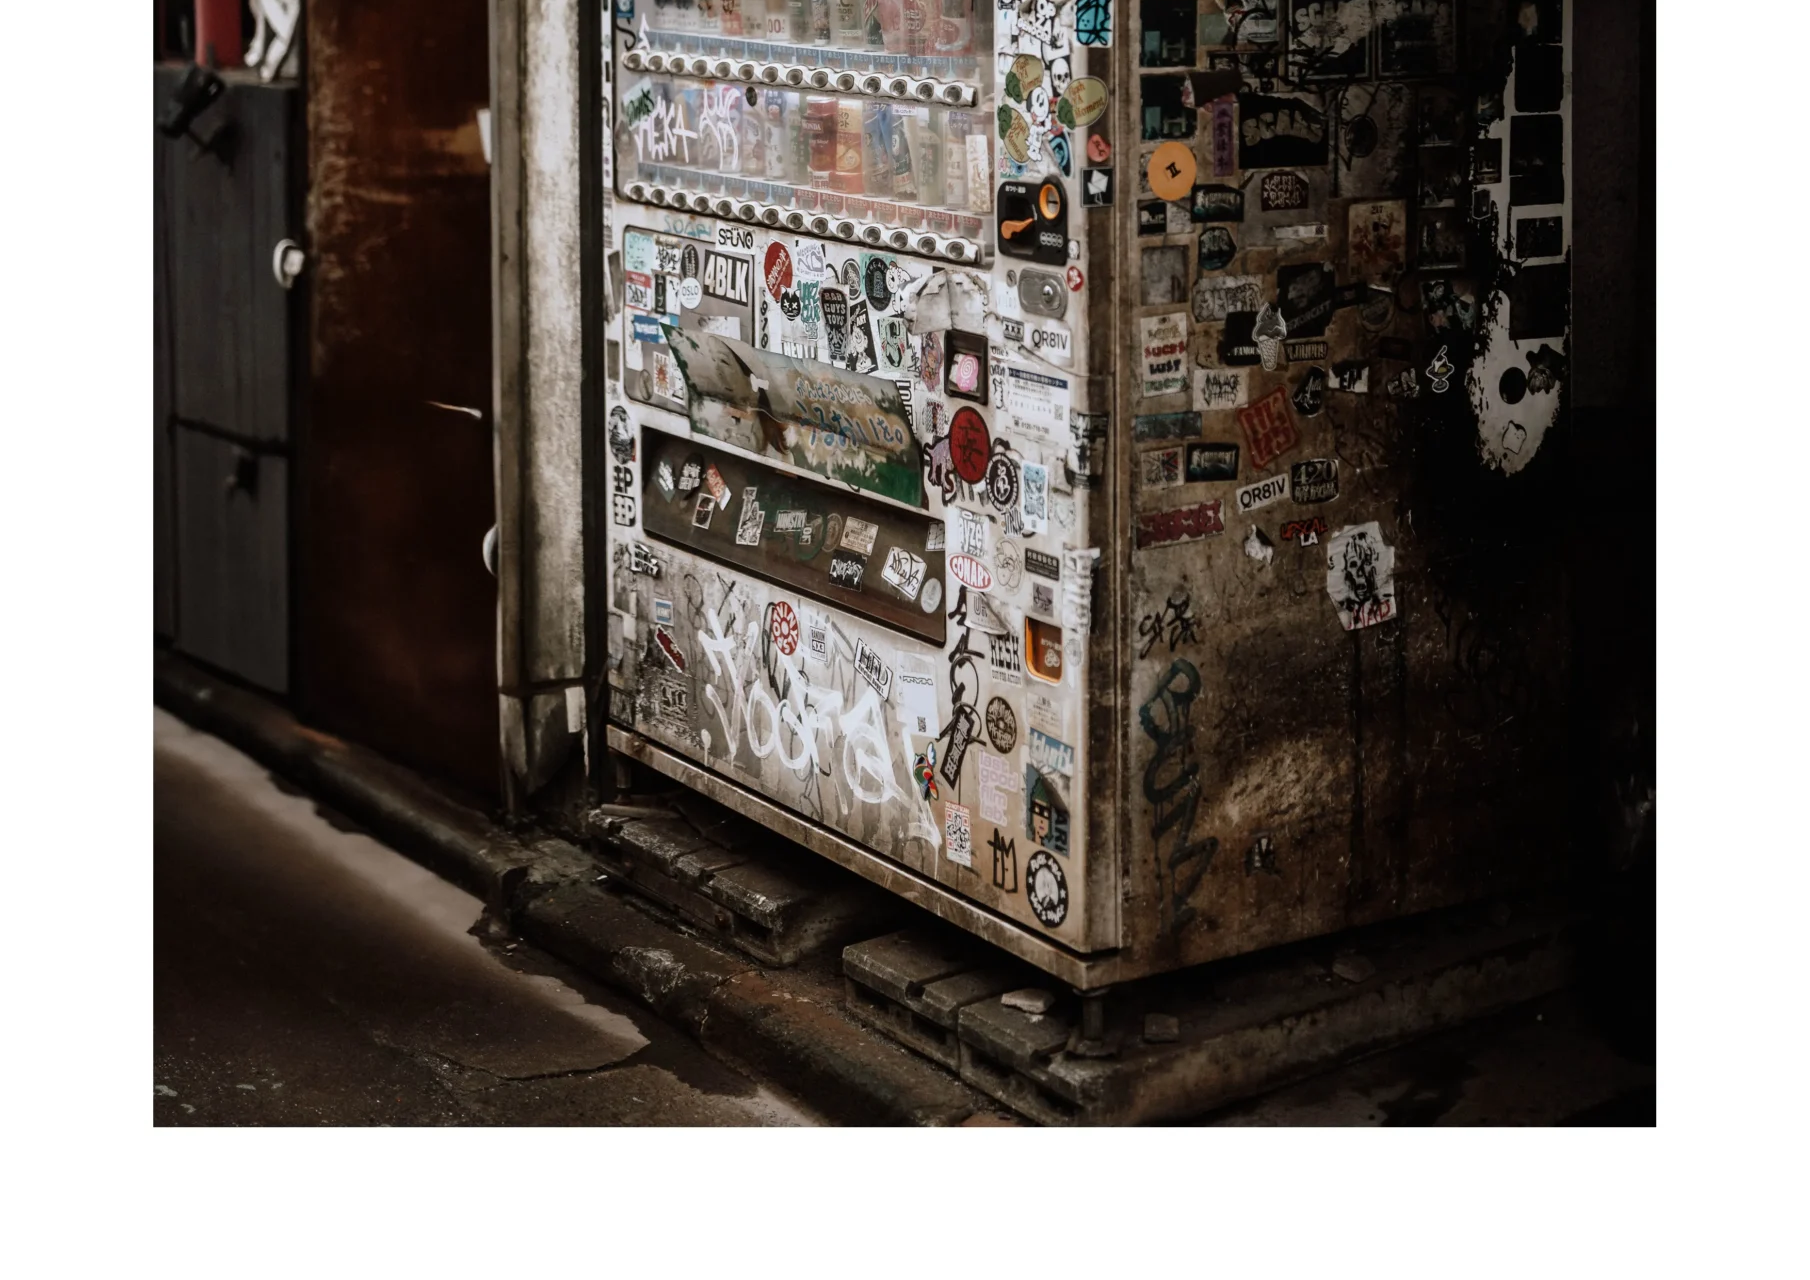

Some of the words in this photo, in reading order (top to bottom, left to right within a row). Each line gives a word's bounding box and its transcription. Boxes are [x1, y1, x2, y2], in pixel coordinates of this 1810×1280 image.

[704, 253, 749, 303] 4BLK
[681, 285, 699, 297] OSLO
[824, 292, 843, 302] BAD
[824, 303, 846, 314] GUYS
[826, 314, 845, 326] TOYS
[1032, 329, 1068, 351] QR81V
[1293, 460, 1337, 485] 420
[1240, 478, 1286, 508] QR81V
[1300, 531, 1319, 547] LA
[952, 555, 991, 588] CONART
[981, 752, 1009, 771] last
[981, 769, 1018, 791] good
[981, 786, 1007, 810] film
